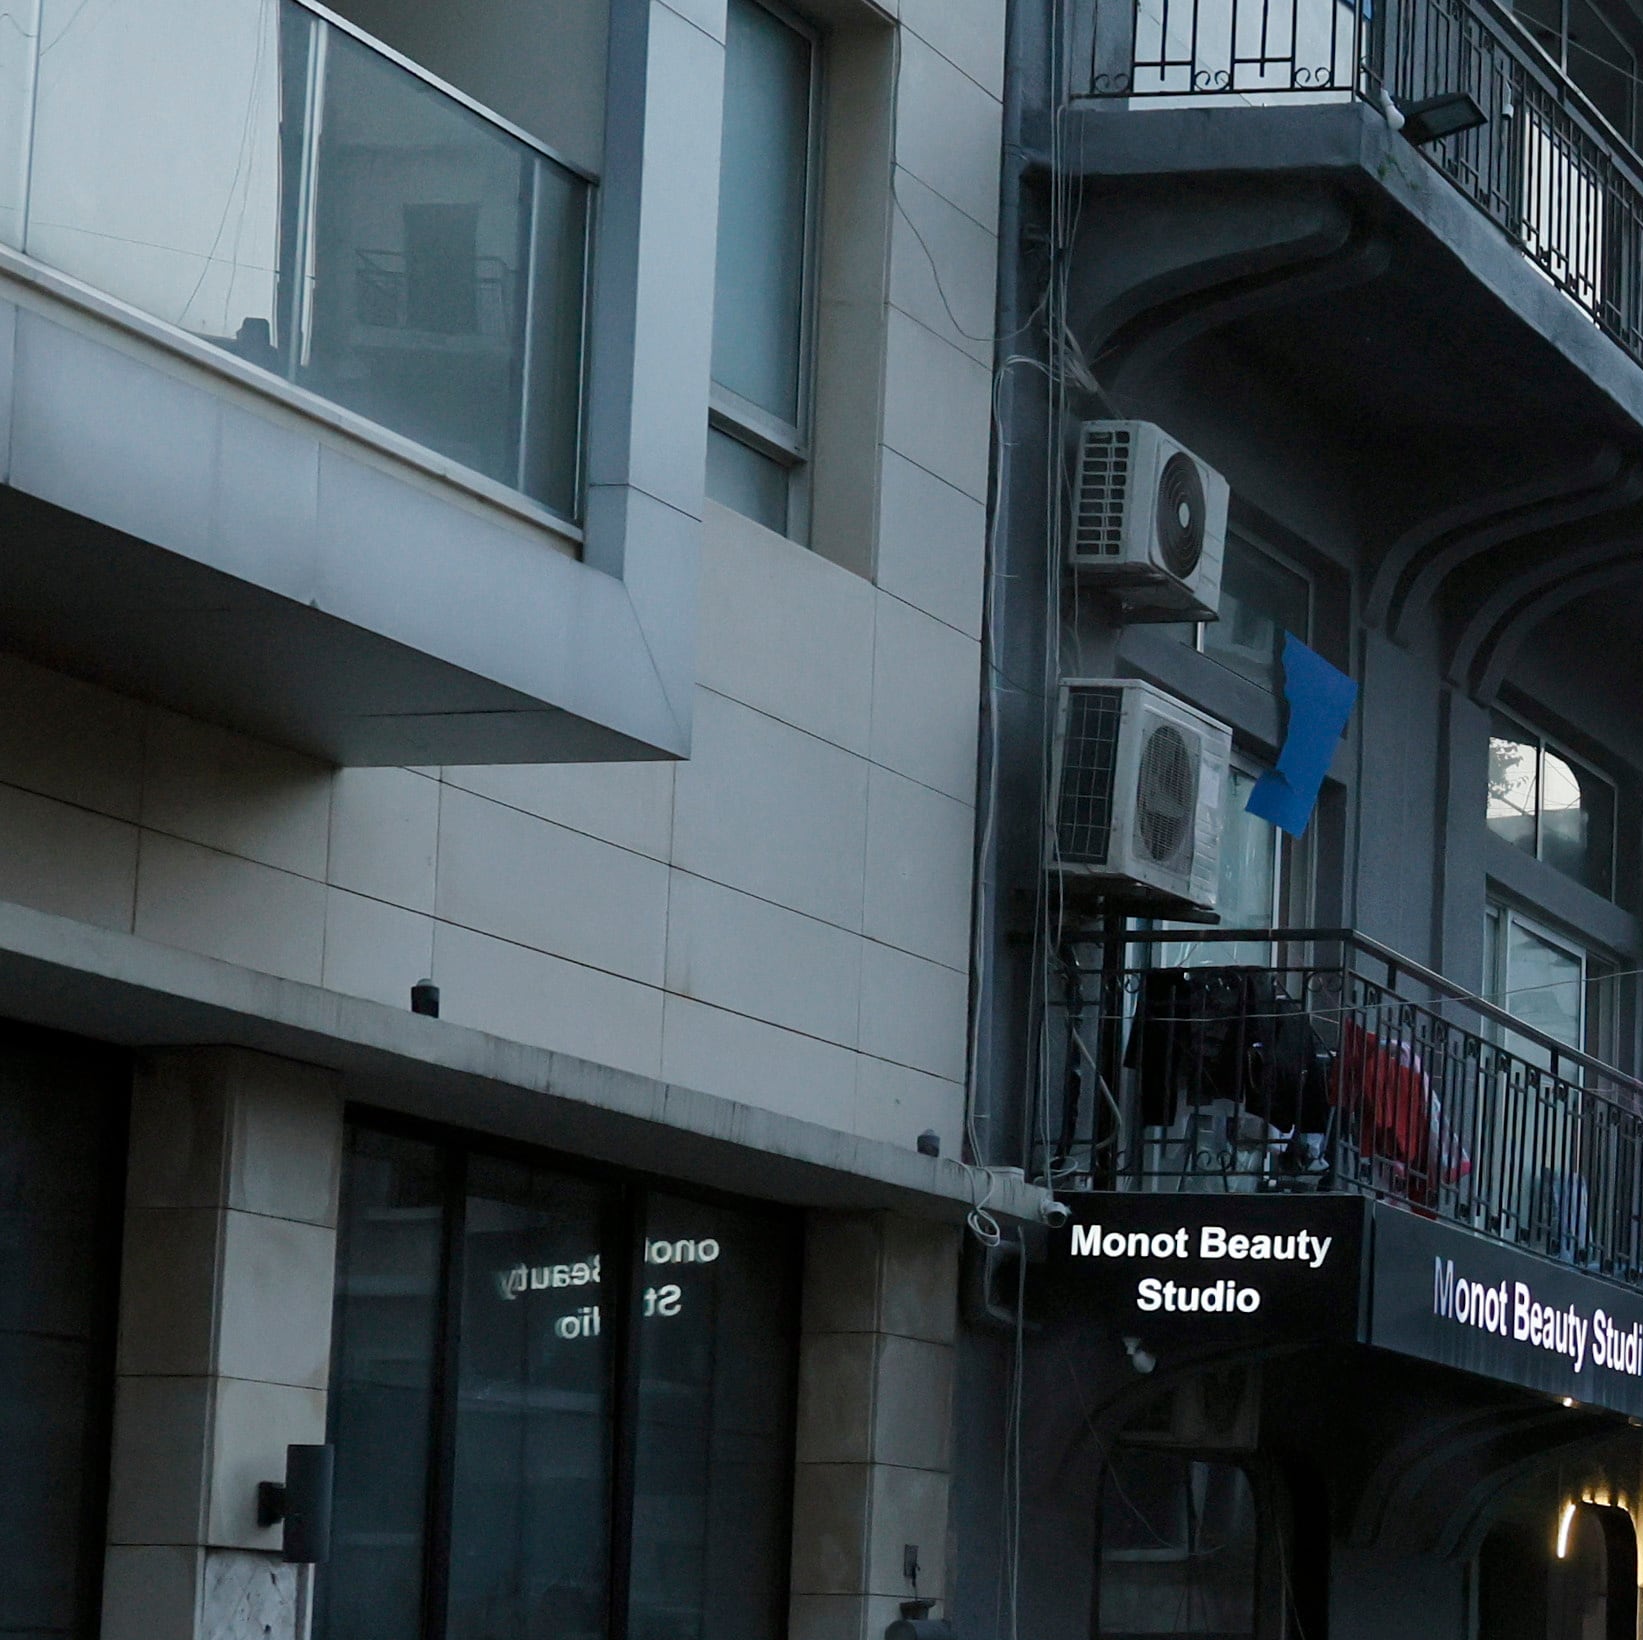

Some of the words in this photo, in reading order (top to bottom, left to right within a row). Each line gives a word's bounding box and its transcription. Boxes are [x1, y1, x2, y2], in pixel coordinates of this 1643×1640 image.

[1070, 1224, 1189, 1259] Monot
[1199, 1225, 1333, 1269] Beauty
[1136, 1276, 1262, 1314] Studio
[1433, 1255, 1509, 1337] Monot
[1512, 1280, 1588, 1374] Beauty
